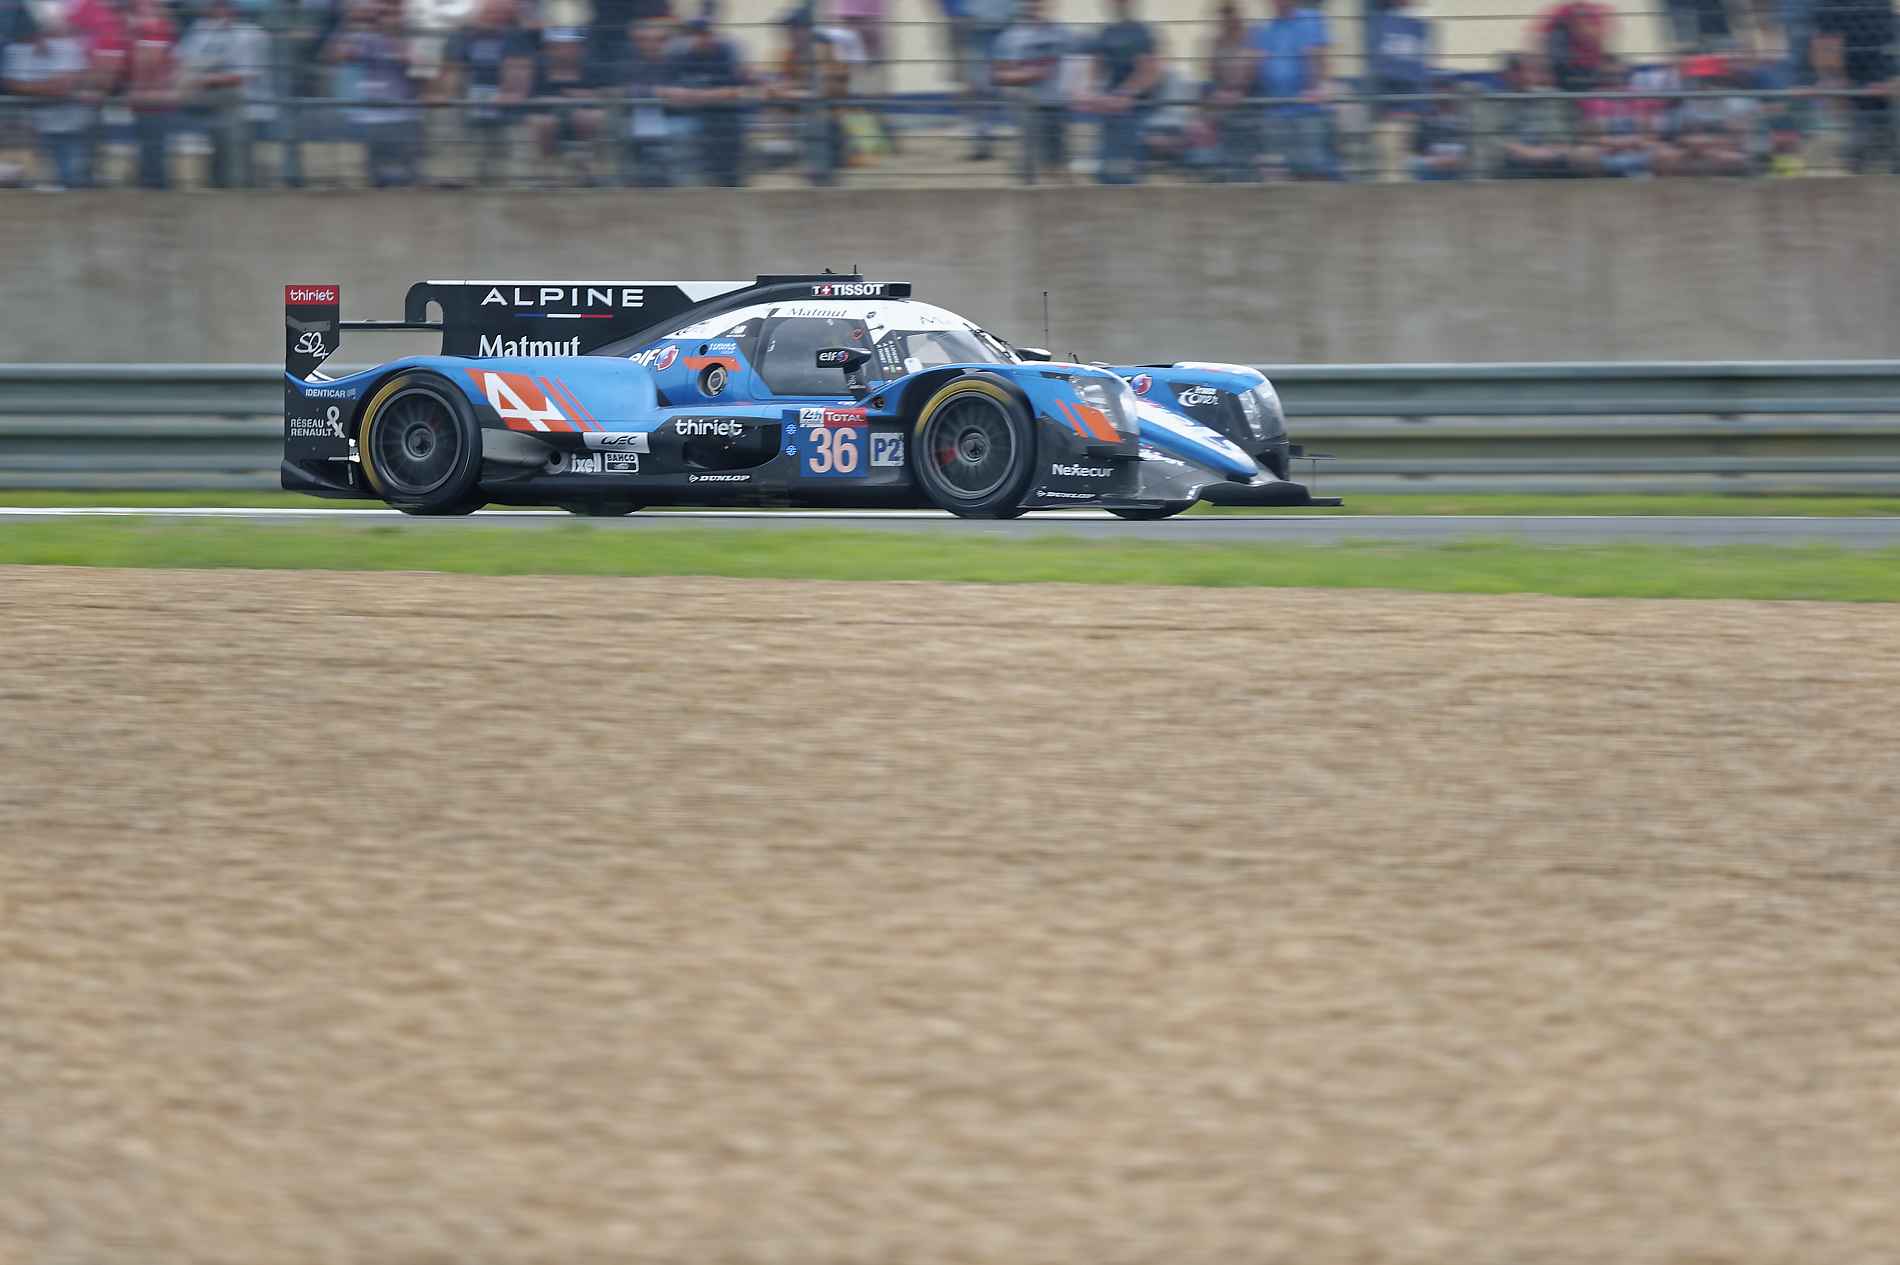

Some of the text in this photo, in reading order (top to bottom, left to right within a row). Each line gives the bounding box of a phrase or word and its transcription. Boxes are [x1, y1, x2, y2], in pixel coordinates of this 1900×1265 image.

[290, 289, 334, 300] thiriet
[832, 283, 884, 295] TISSOT
[481, 287, 644, 307] ALPINE
[790, 308, 848, 317] Matmut
[479, 334, 581, 357] Matmut
[819, 352, 838, 361] elf
[305, 389, 345, 397] IDENTICAR
[290, 428, 333, 437] RENAULT
[675, 419, 743, 437] thiriet
[600, 435, 638, 445] WEC
[808, 427, 858, 473] 36
[873, 438, 903, 462] P2
[1052, 463, 1114, 478] Nexecur
[699, 474, 750, 482] DUNLOP
